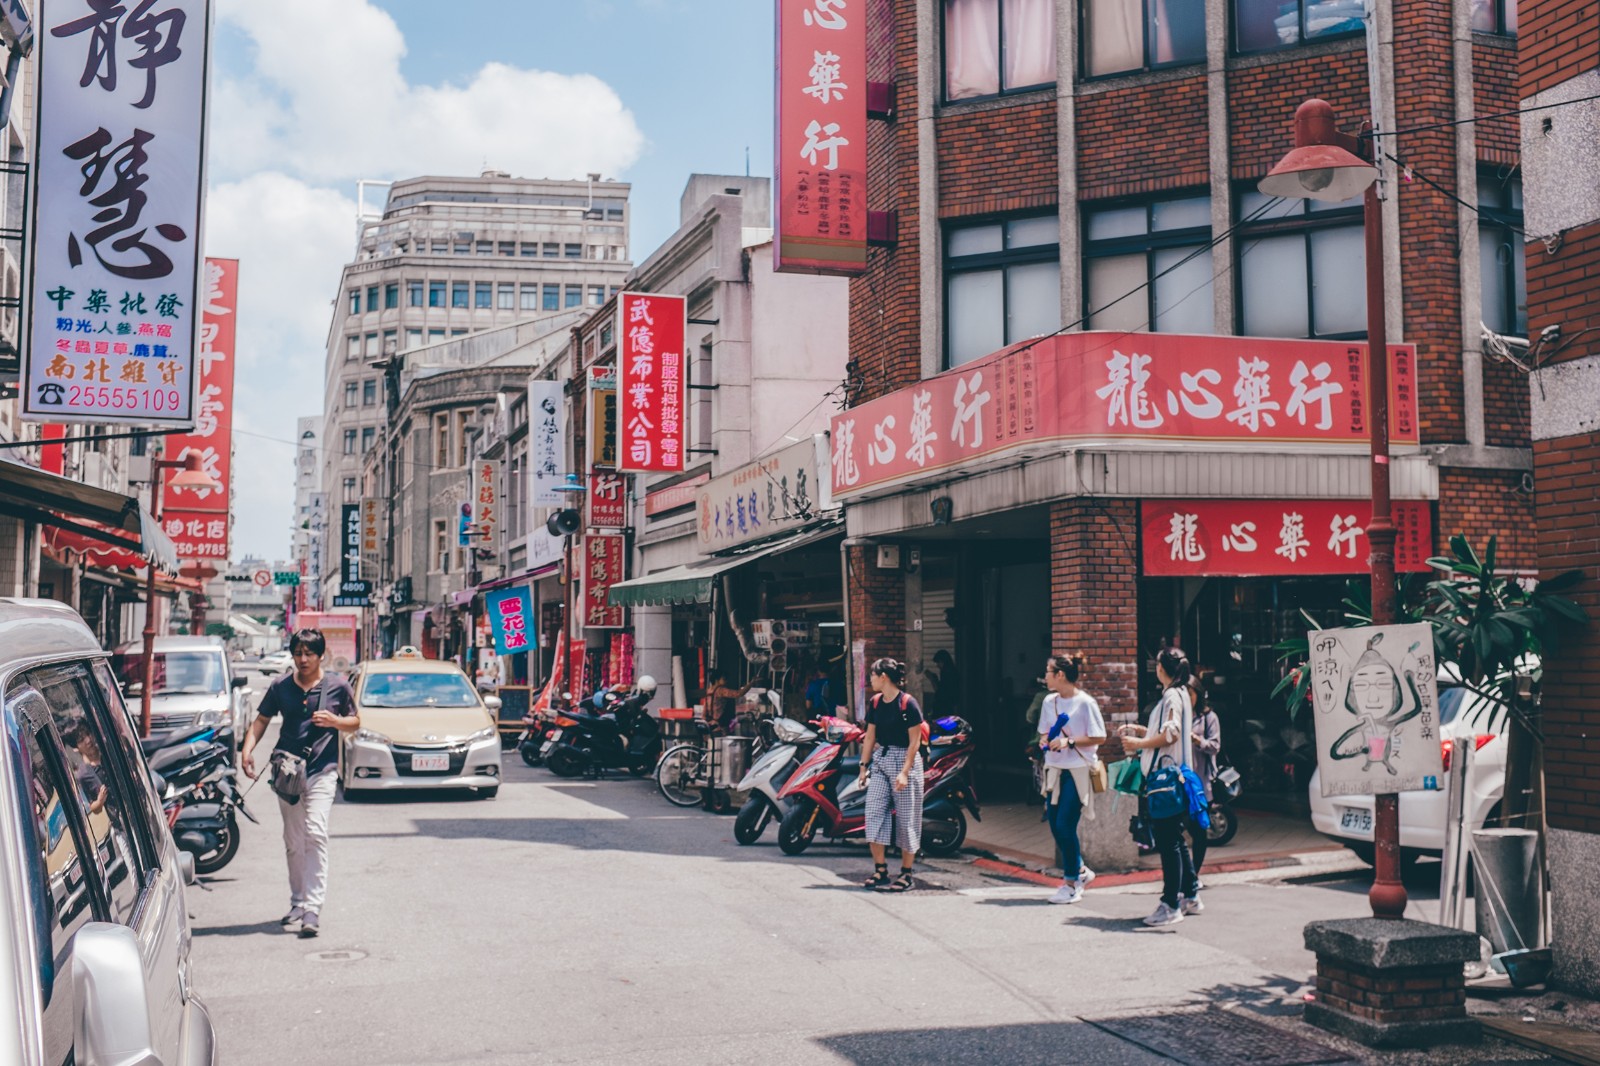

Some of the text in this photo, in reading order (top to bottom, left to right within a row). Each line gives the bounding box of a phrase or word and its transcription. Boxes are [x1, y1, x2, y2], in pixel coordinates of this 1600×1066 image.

[800, 0, 849, 170] 心藥行
[46, 286, 183, 319] 中藥批發
[45, 354, 183, 387] 南北雜貨
[628, 297, 654, 467] 武億布業公司
[1095, 349, 1344, 433] 龍心藥行
[68, 385, 180, 411] 25555109
[832, 370, 991, 488] 龍心藥行
[595, 474, 622, 500] 行
[166, 518, 226, 539] 迪化店
[1164, 511, 1364, 564] 龍心藥行
[498, 597, 528, 650] 雪花冰
